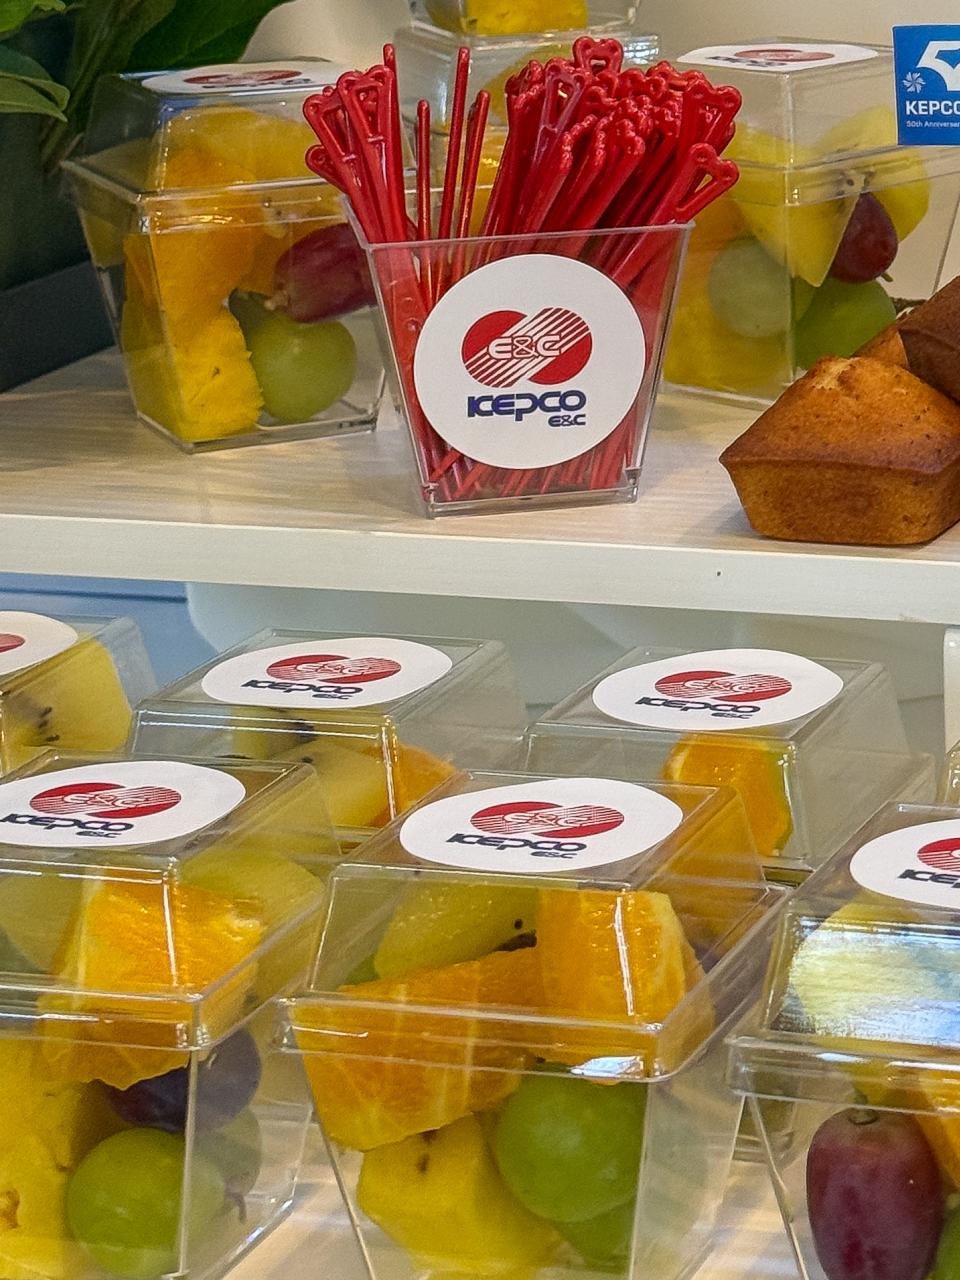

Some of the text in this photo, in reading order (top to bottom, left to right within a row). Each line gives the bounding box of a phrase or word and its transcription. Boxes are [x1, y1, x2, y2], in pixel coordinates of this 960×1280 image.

[488, 333, 562, 360] E&C
[467, 390, 587, 421] KEPCO
[548, 414, 586, 427] E&C
[634, 696, 761, 713] KEPCO
[446, 833, 587, 851] KEPCO
